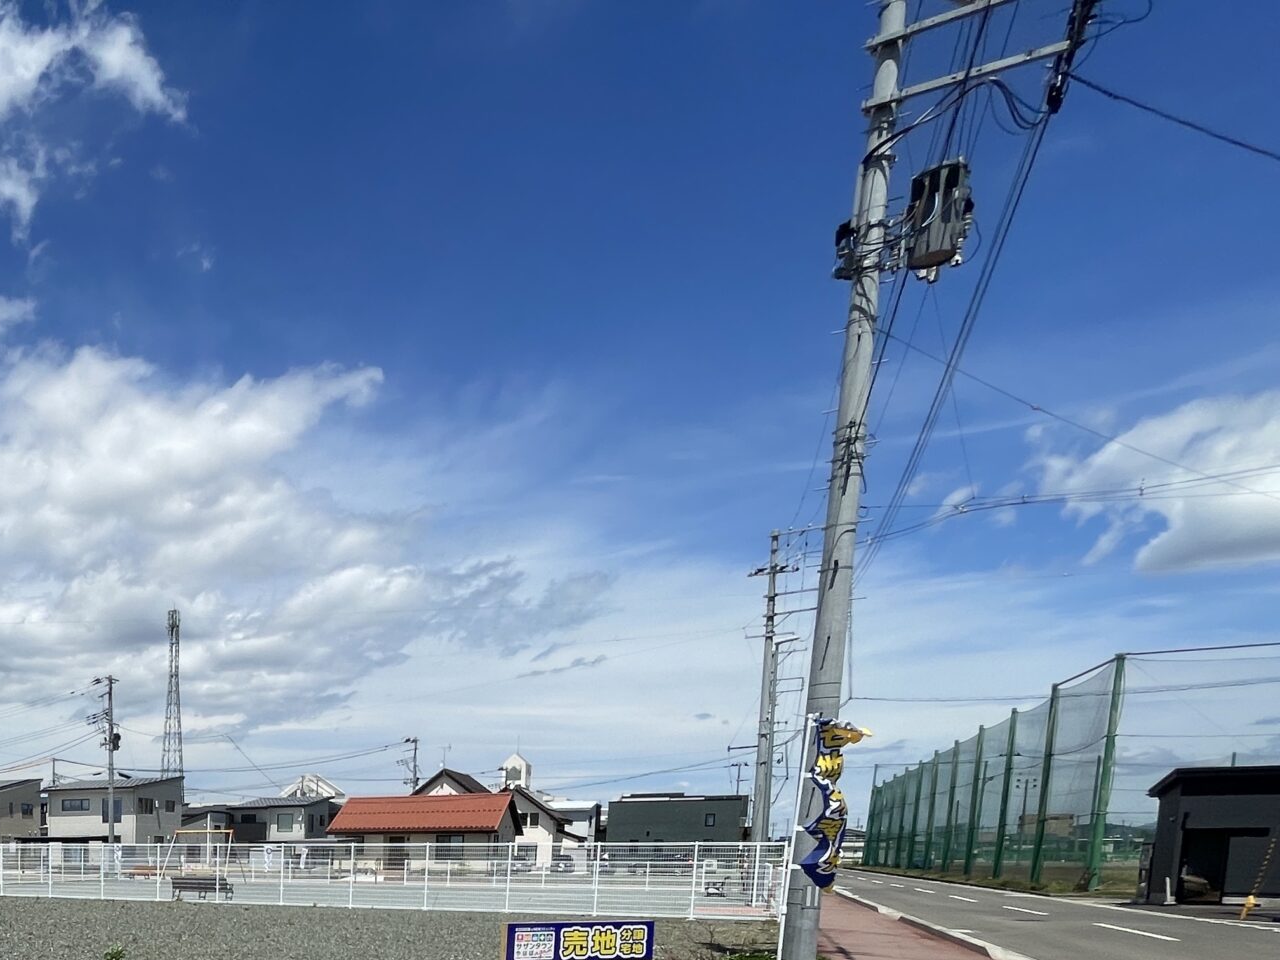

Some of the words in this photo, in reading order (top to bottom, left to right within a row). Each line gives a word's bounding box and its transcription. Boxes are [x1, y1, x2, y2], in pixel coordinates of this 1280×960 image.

[516, 942, 553, 950] サザンタウン
[562, 928, 617, 957] 売地
[619, 942, 644, 954] 宅地
